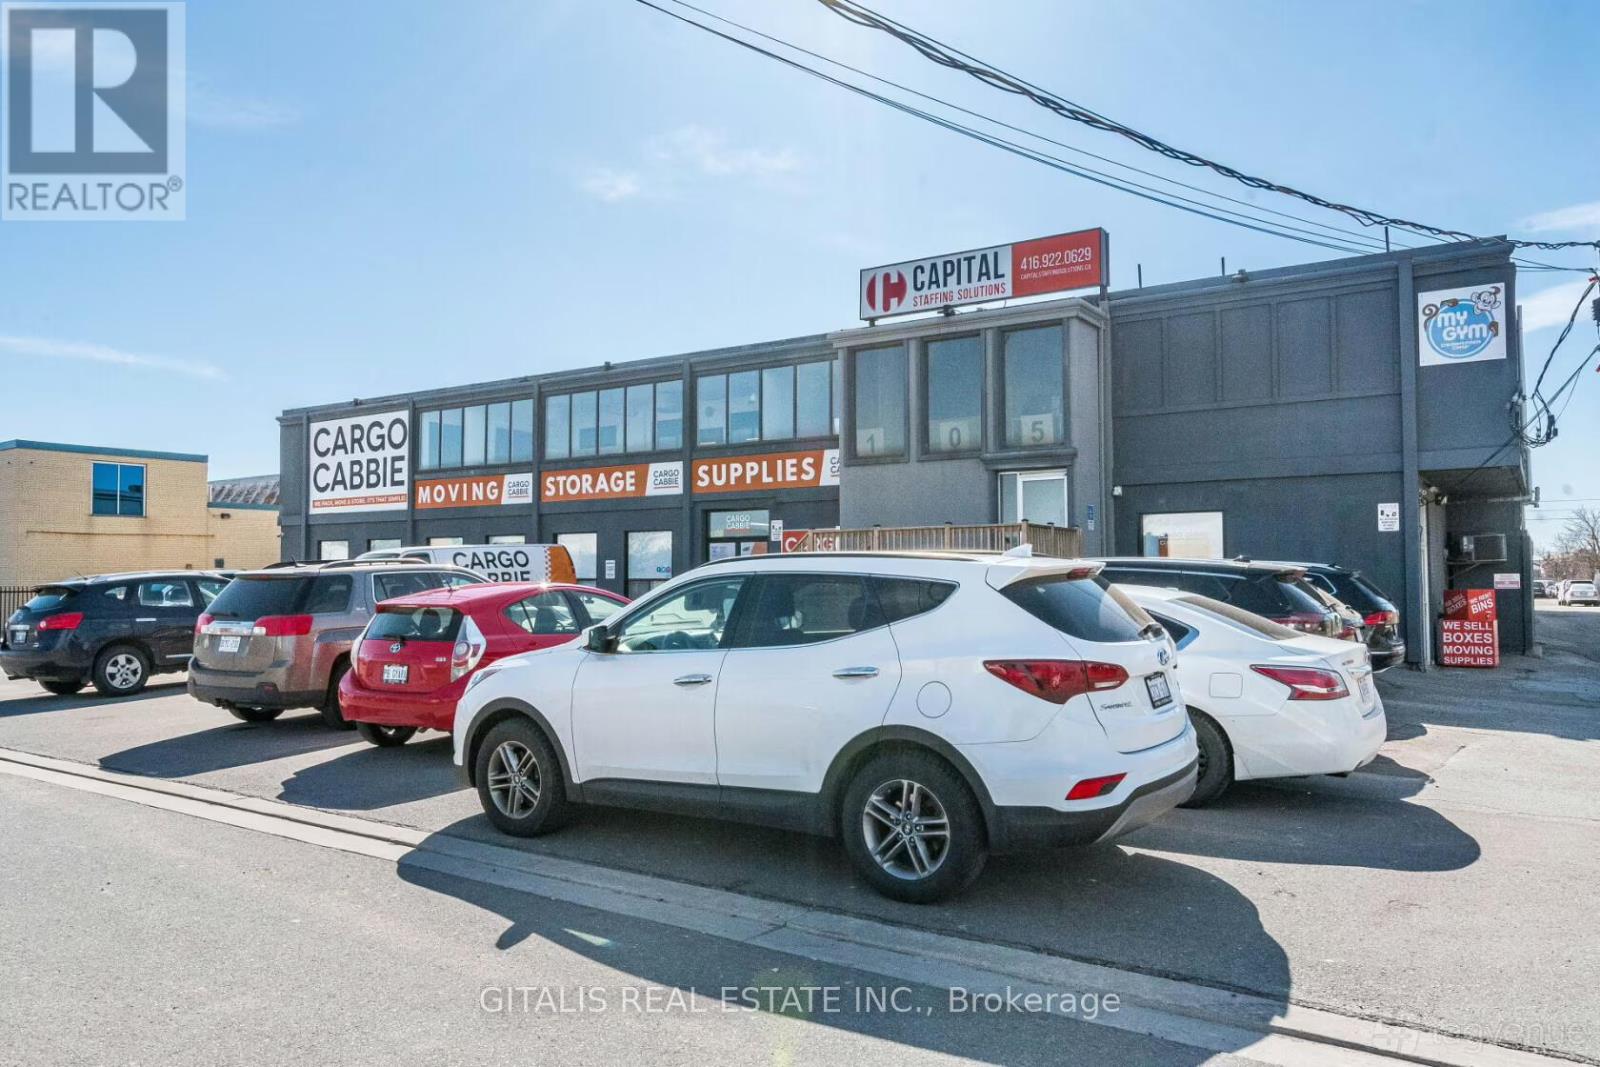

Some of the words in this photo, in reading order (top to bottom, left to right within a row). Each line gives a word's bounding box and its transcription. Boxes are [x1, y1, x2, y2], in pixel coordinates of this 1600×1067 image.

[1021, 247, 1091, 270] 416.922.0629
[913, 251, 1005, 291] CAPITAL
[913, 290, 954, 307] STAFFING
[957, 282, 1006, 301] SOLUTIONS
[313, 418, 408, 458] CARGO
[866, 434, 876, 453] 1
[950, 426, 961, 448] 0
[1031, 421, 1045, 442] 5
[313, 455, 405, 493] CABBIE
[653, 469, 679, 478] CARGO
[653, 477, 679, 486] CABBIE
[697, 457, 816, 487] SUPPLIES
[418, 481, 499, 504] MOVING
[508, 480, 530, 488] CARGO
[545, 470, 636, 497] STORAGE
[726, 514, 751, 522] CARGO
[452, 550, 530, 570] CARGO
[1471, 598, 1494, 614] BINS
[1443, 621, 1461, 630] WE
[1464, 622, 1492, 630] SELL
[1443, 632, 1493, 643] BOXES
[1443, 645, 1494, 655] MOVING
[1444, 656, 1494, 665] SUPPLIES
